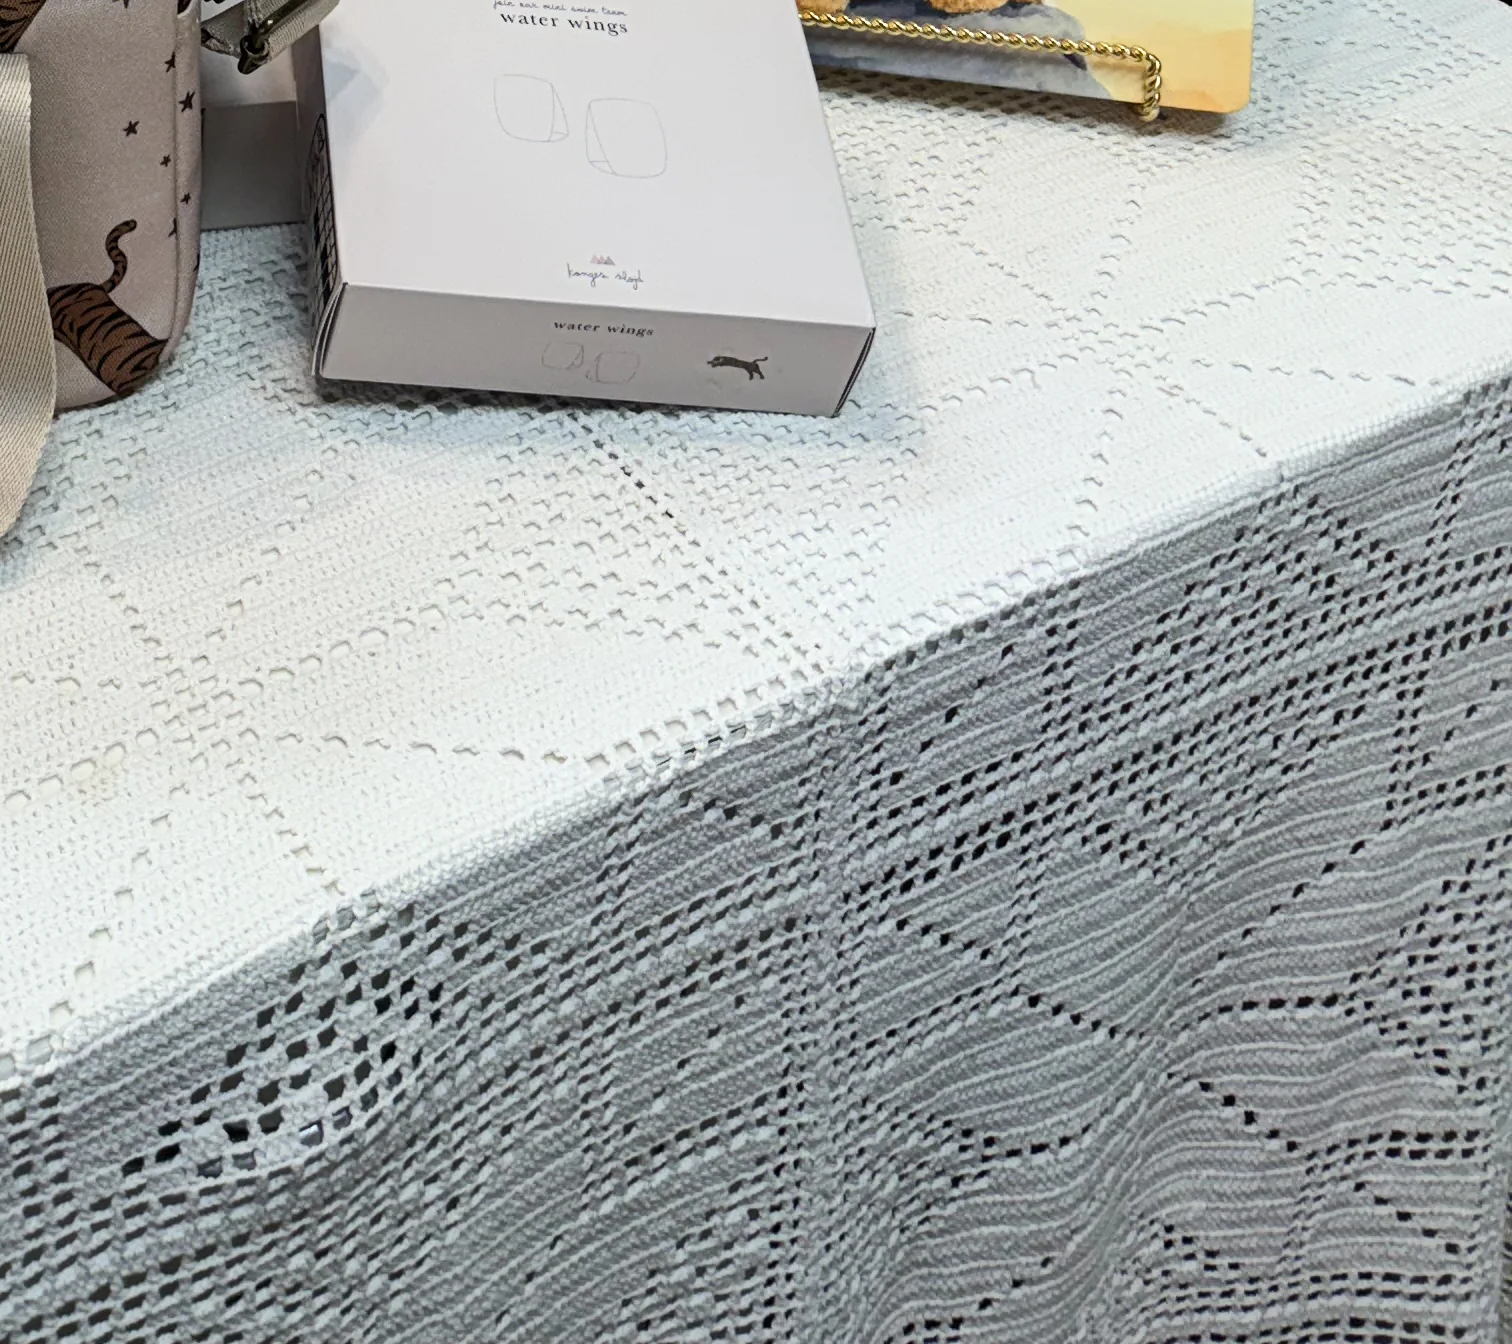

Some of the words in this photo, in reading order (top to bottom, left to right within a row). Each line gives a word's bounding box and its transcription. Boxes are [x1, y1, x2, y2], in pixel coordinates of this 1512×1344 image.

[500, 12, 560, 27] water
[567, 15, 629, 37] wings
[553, 321, 601, 332] water
[607, 323, 655, 338] wings
